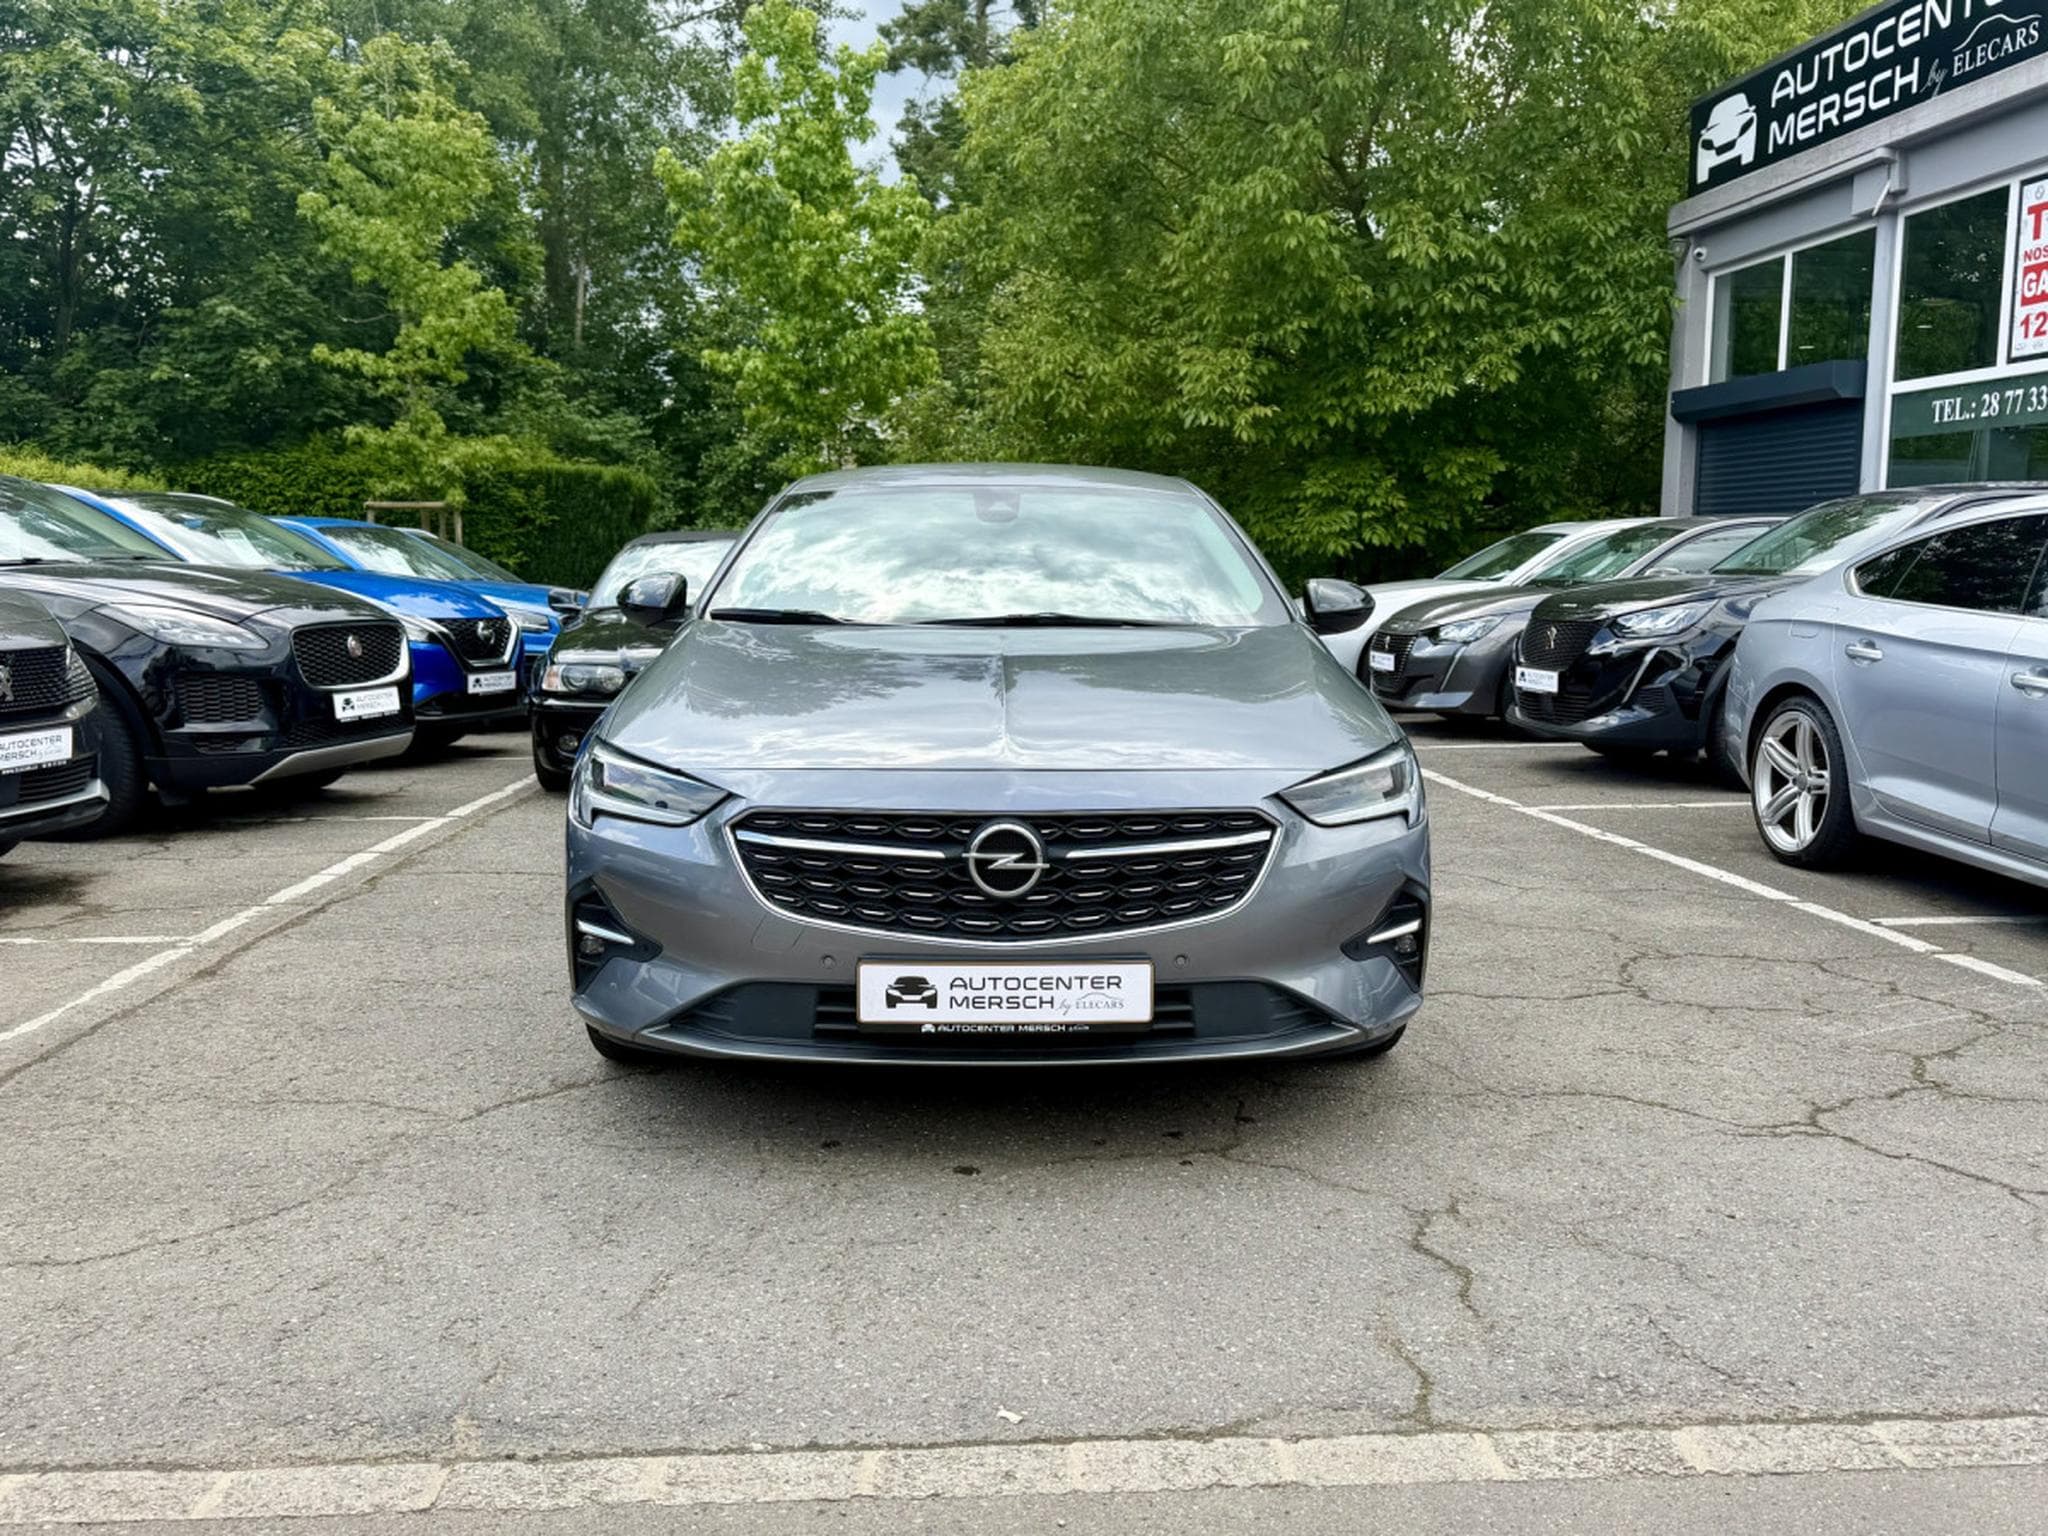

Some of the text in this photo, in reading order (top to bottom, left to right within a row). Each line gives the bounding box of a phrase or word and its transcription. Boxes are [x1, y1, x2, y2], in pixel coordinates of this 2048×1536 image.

[1768, 21, 2040, 154] MERSCH by ELECARS
[1931, 385, 2048, 424] TEL.: 28 77 33
[950, 976, 1122, 991] AUTOCENTER
[950, 996, 1054, 1009] MERSCH
[1055, 999, 1071, 1016] by
[937, 1024, 1015, 1033] AUTOCENTER
[1018, 1024, 1066, 1033] MERSCH
